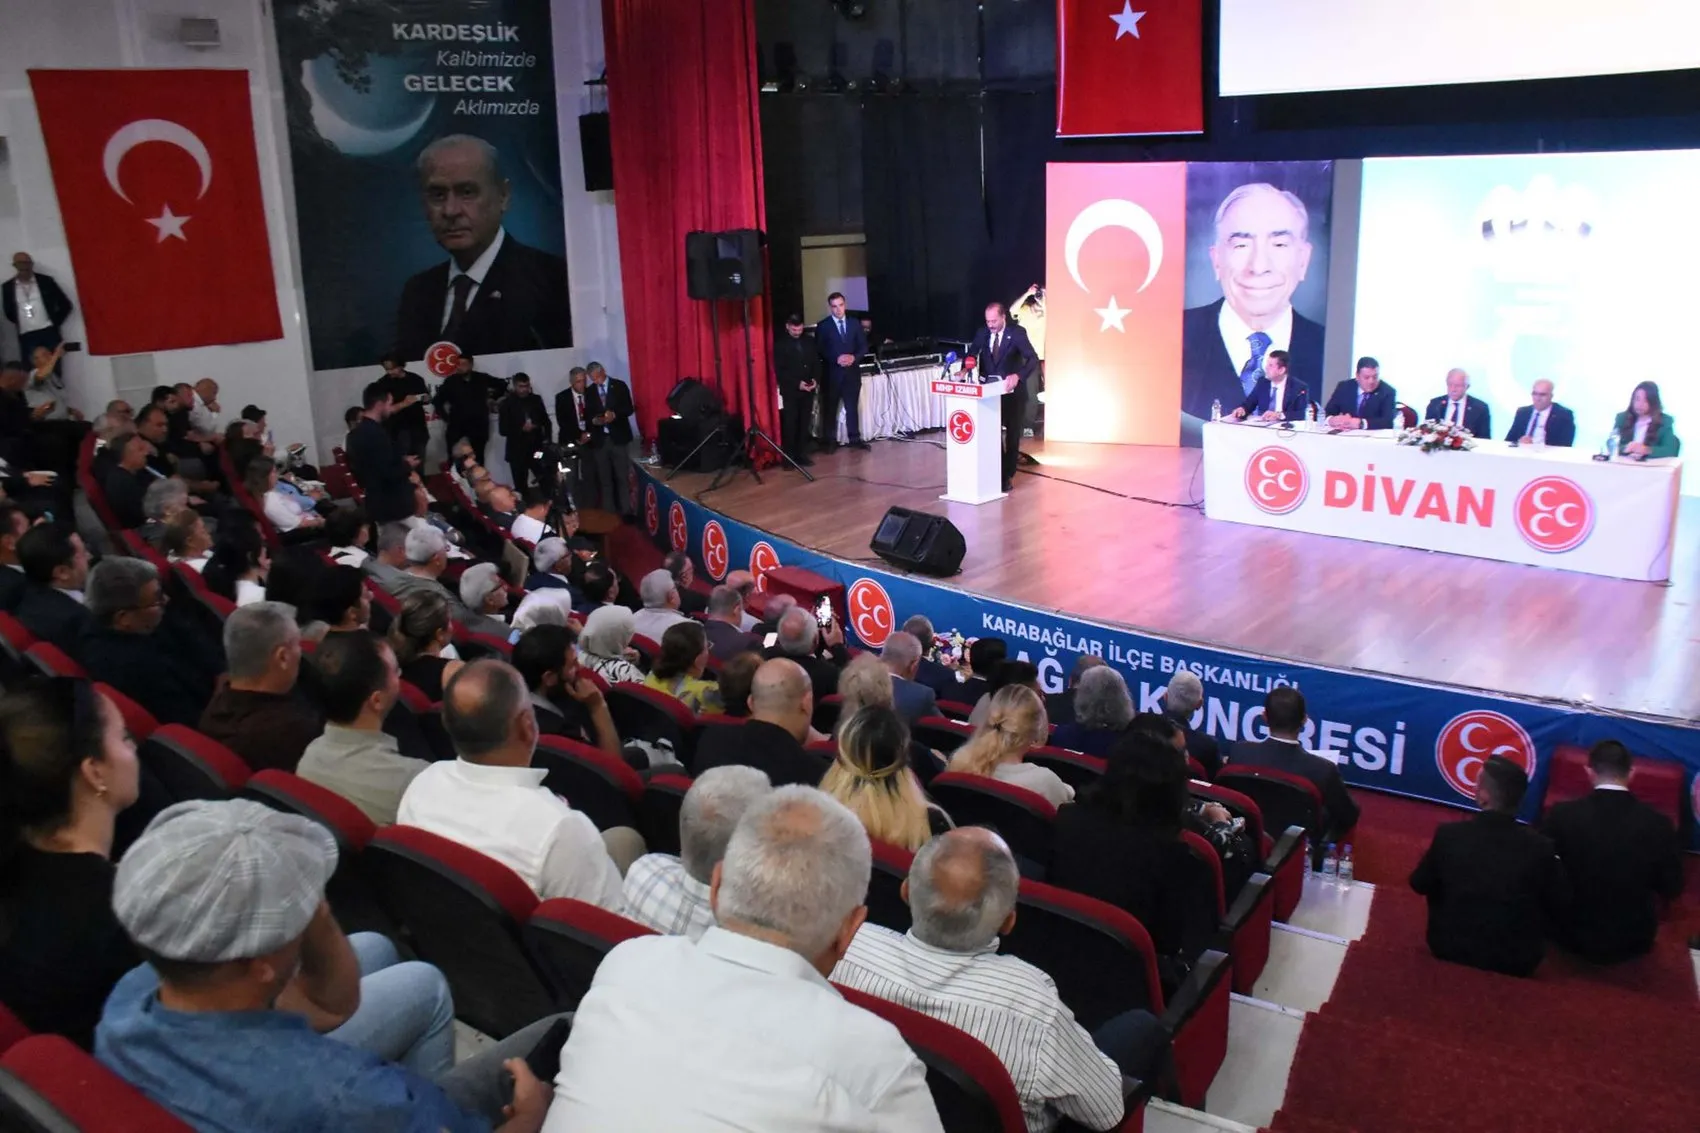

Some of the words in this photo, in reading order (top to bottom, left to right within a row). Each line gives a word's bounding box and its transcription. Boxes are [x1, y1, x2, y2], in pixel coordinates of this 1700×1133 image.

[392, 22, 520, 43] KARDEŞLİK
[436, 51, 536, 68] Kalbimizde
[404, 75, 515, 92] GELECEK
[453, 100, 540, 115] Aklımızda
[1323, 464, 1496, 528] DİVAN
[982, 613, 1103, 657] KARABAĞLAR
[1109, 640, 1154, 670] İLÇE
